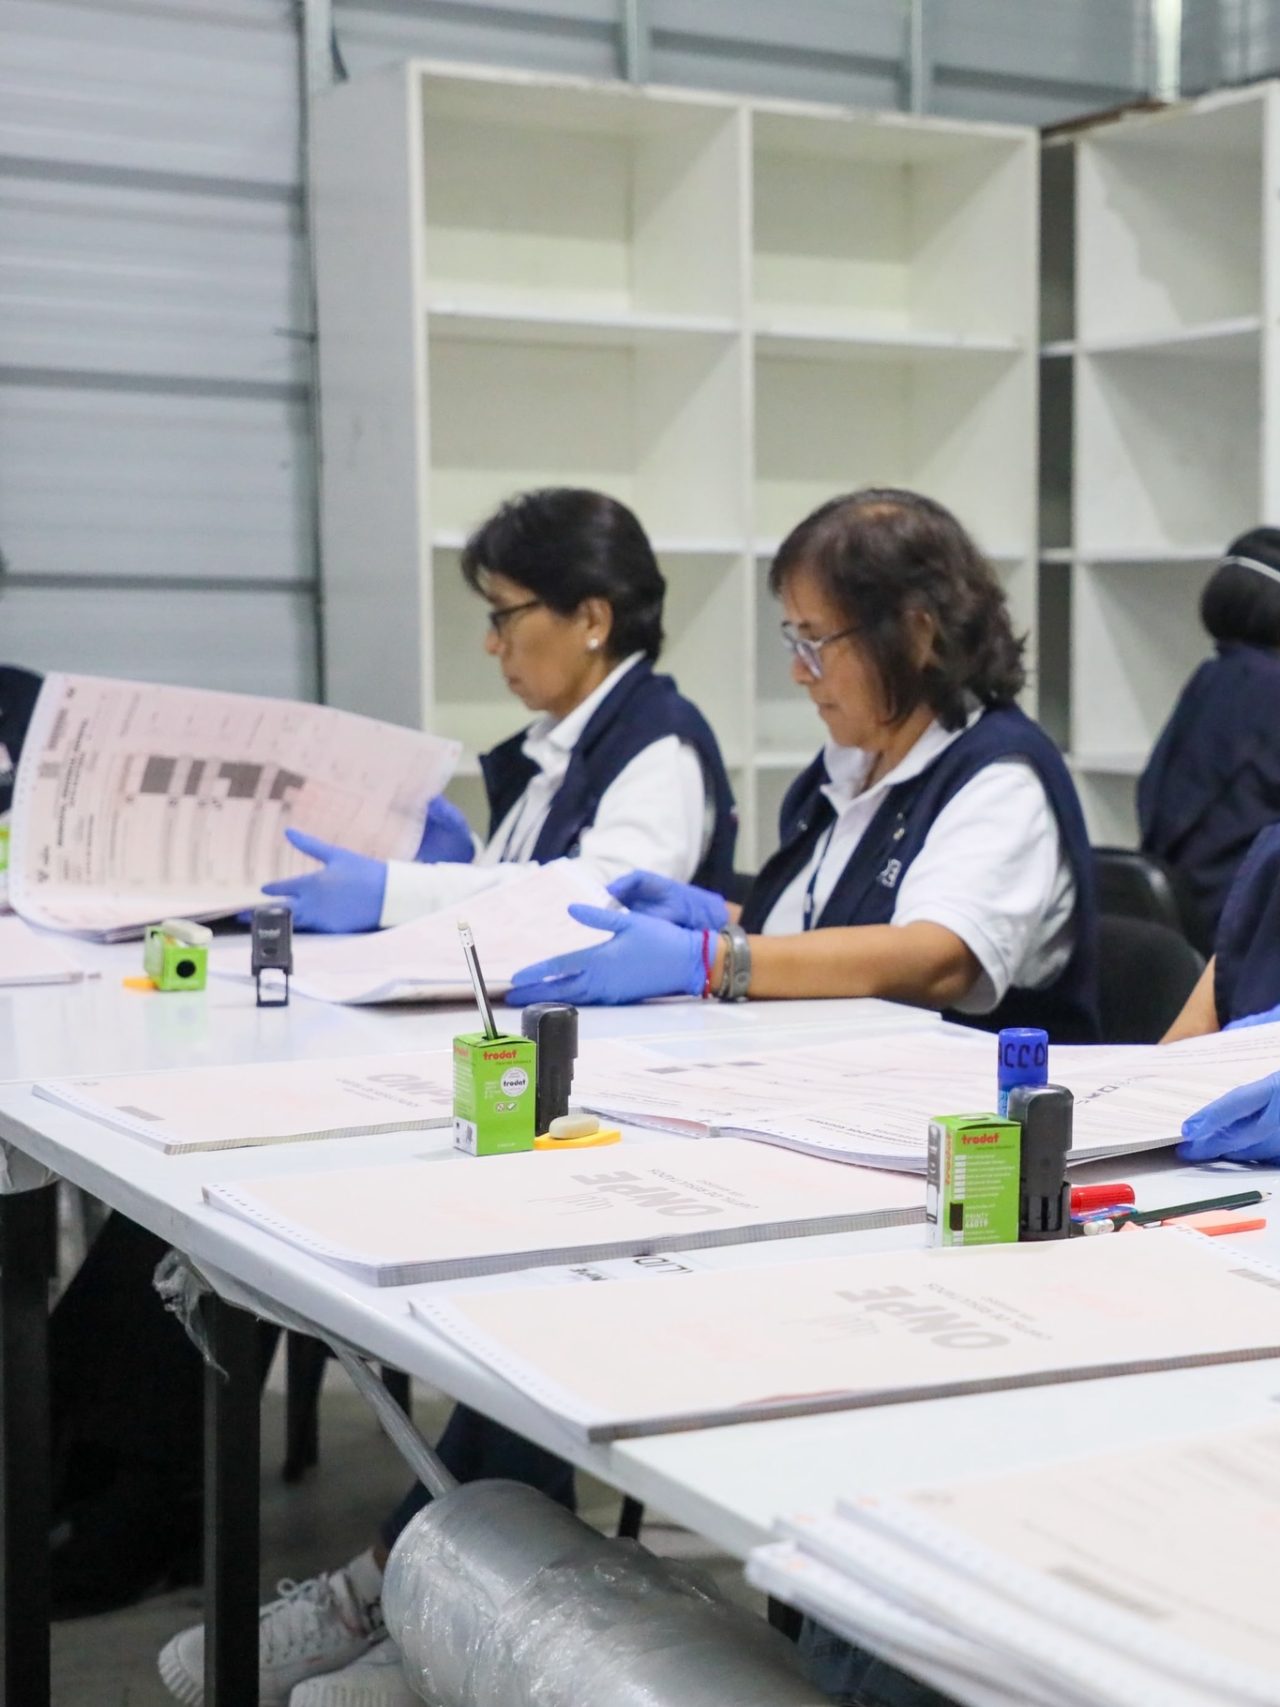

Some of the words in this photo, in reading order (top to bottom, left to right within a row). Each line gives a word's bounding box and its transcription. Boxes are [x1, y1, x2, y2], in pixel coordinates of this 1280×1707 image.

[483, 1049, 517, 1060] trodat
[503, 1079, 526, 1087] trodat
[961, 1133, 1000, 1144] trodat
[571, 1170, 724, 1217] ONPE
[834, 1285, 1011, 1350] ONPE
